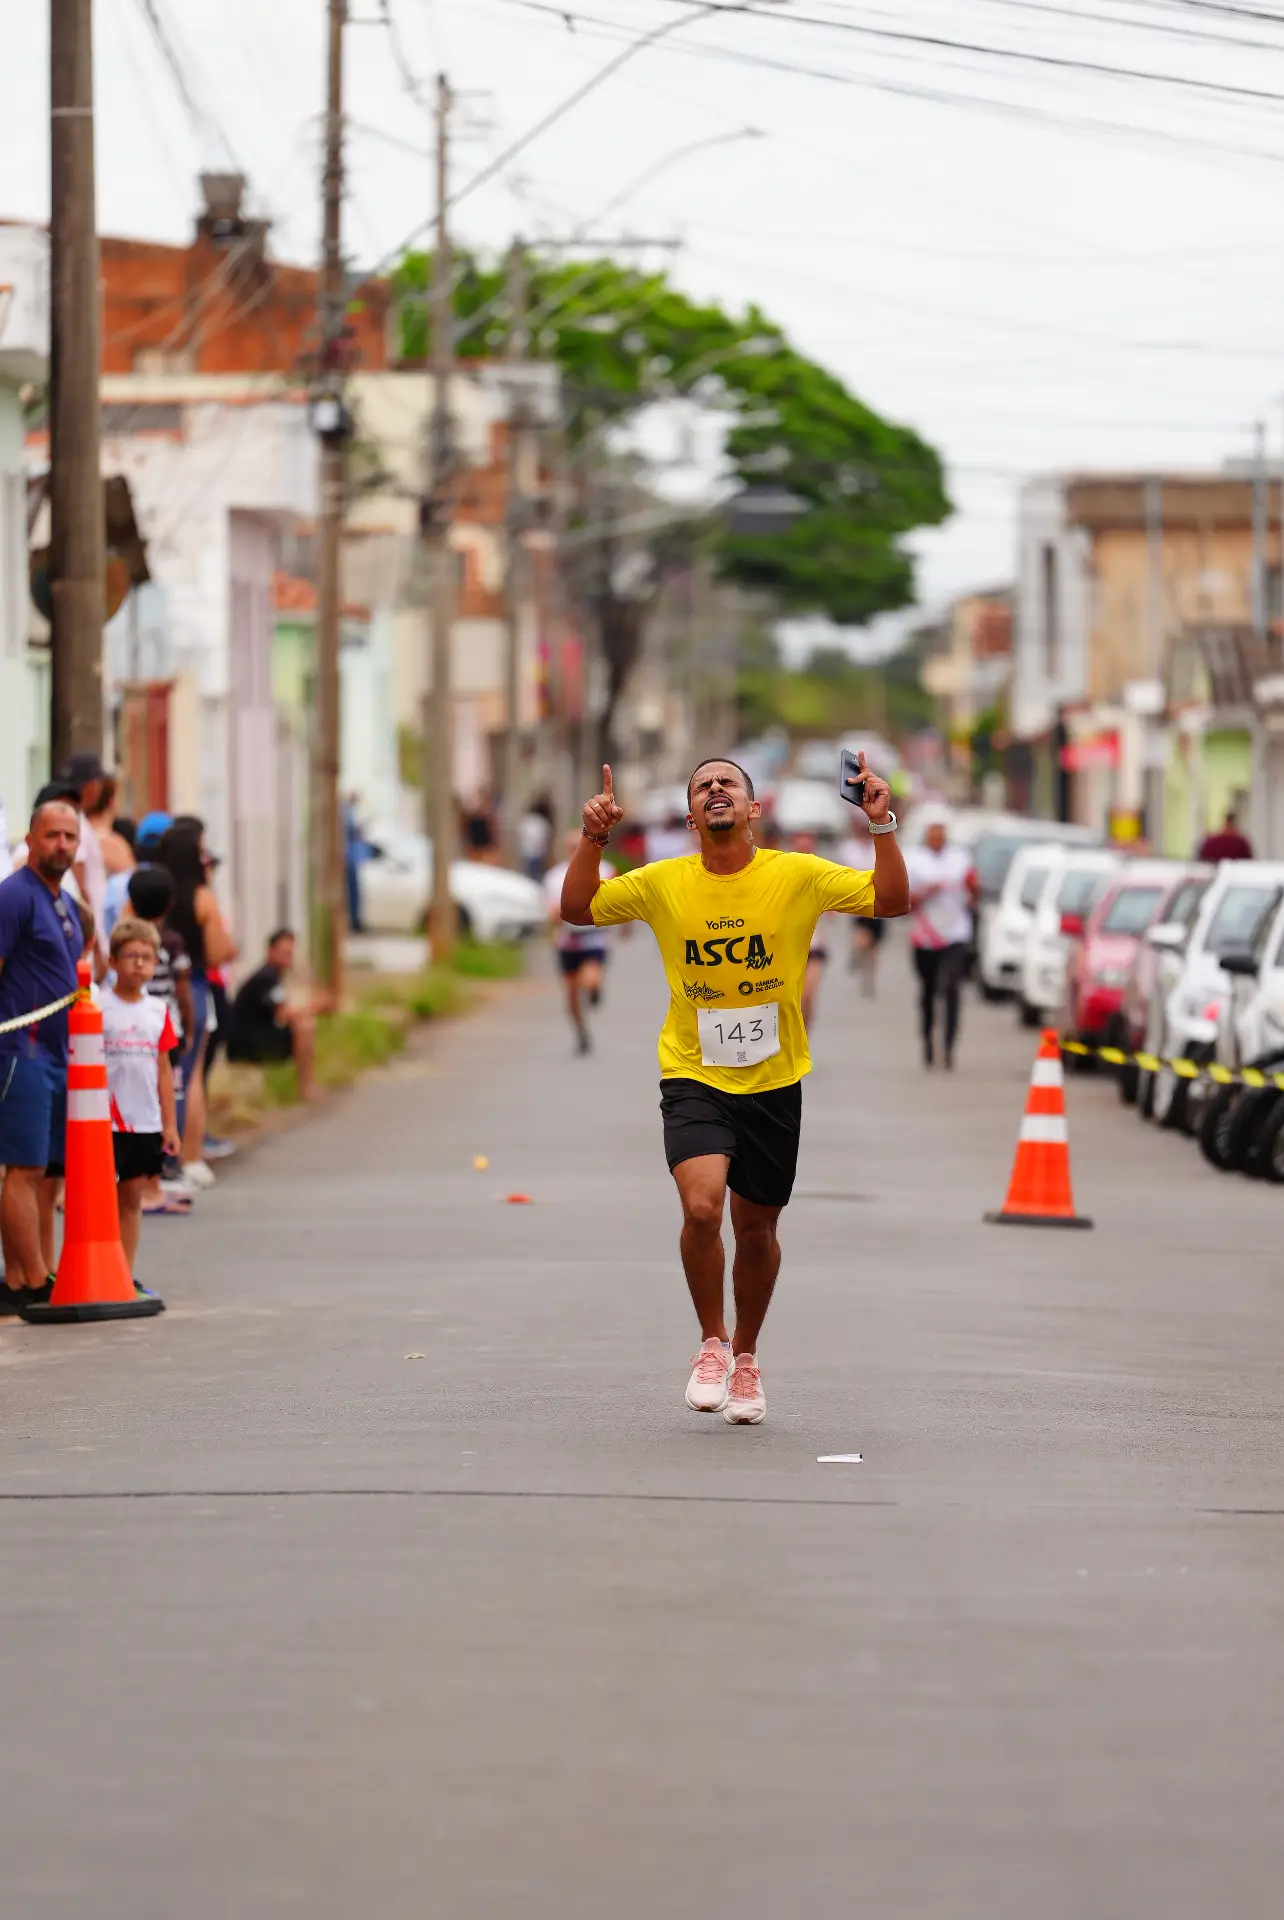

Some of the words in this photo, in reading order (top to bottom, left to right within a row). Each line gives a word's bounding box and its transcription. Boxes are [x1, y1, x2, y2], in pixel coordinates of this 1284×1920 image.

[705, 918, 745, 930] YoPRO
[686, 934, 766, 967] ASCA
[744, 951, 774, 971] RUN
[714, 1019, 764, 1045] 143
